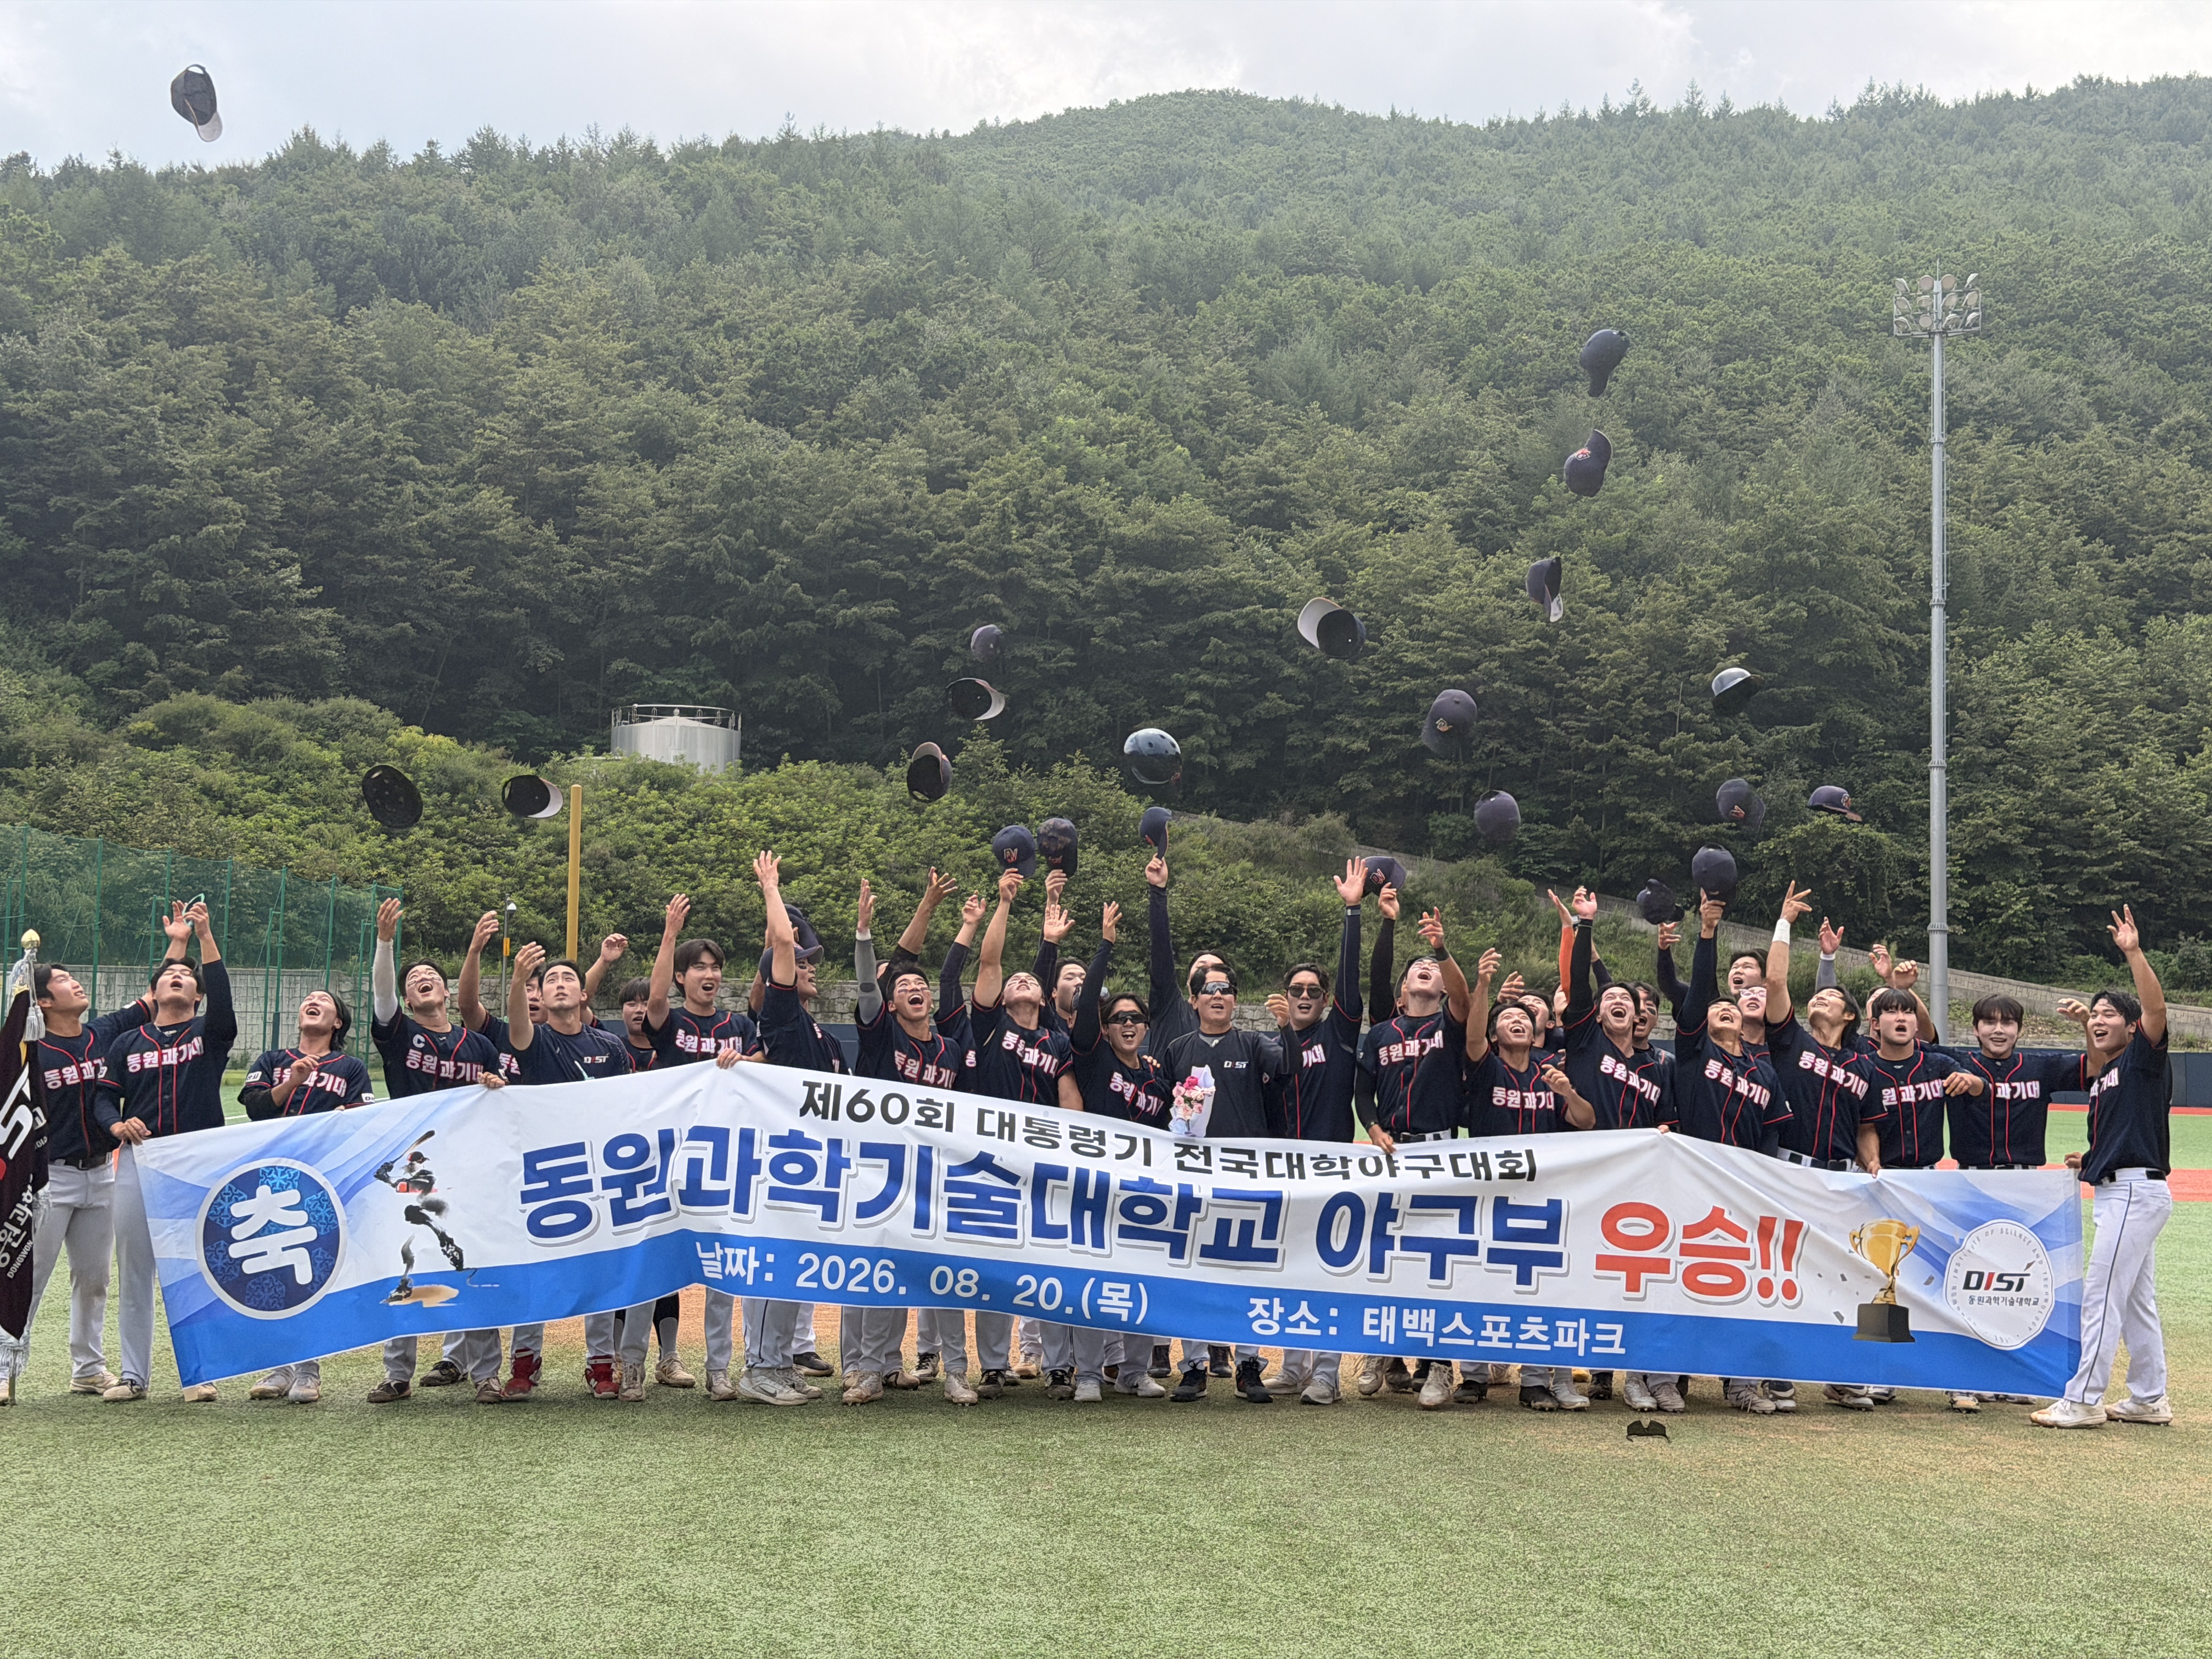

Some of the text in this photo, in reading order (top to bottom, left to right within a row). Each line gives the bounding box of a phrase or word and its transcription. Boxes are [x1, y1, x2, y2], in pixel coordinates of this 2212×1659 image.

[127, 1036, 204, 1073] 동원과기대
[413, 1034, 425, 1048] C
[1995, 1081, 2040, 1100] 과기대
[799, 1080, 1537, 1182] 제60회 대통령기 전국대학야구대회
[520, 1125, 1804, 1301] 동원과학기술대학교 야구부 우승!!
[228, 1183, 318, 1286] 축
[695, 1241, 1626, 1357] 날짜: 2026. 08. 20.(목) 장소: 태백스포츠파크
[1962, 1269, 2032, 1293] DIST
[1968, 1295, 2040, 1307] 동원과학기술대학교
